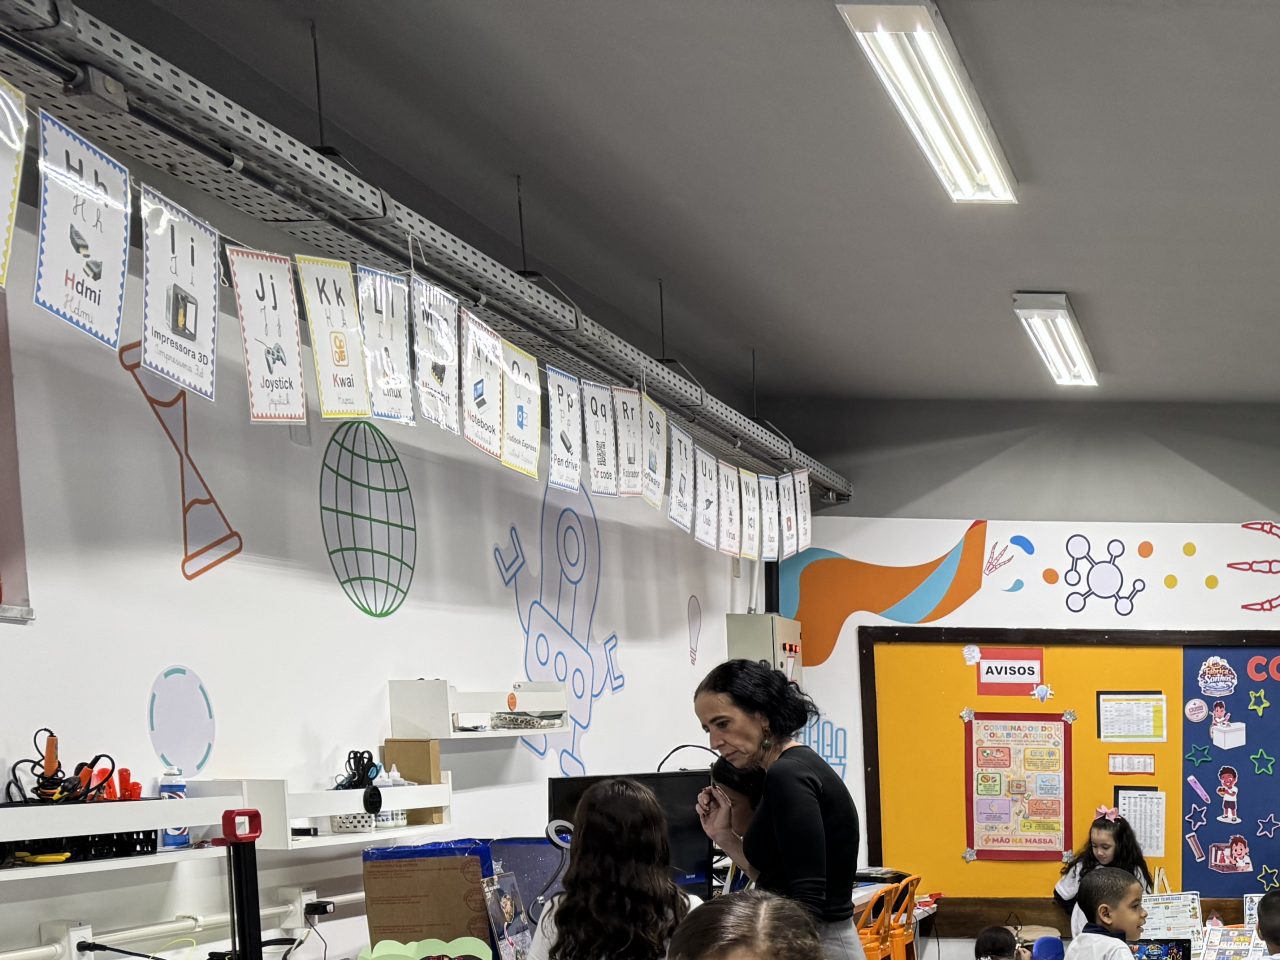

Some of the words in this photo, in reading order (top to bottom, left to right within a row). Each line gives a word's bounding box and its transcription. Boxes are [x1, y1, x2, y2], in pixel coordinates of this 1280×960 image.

[65, 269, 102, 306] Hdmi
[151, 326, 197, 360] Impressora
[197, 352, 209, 366] 3D
[260, 376, 294, 392] Joystick
[332, 373, 355, 388] Kwai
[467, 409, 496, 436] Notebook
[506, 432, 522, 446] Outlook
[521, 439, 537, 454] Express
[564, 457, 579, 472] drive
[985, 666, 1036, 676] AVISOS
[991, 836, 1011, 844] MÃO
